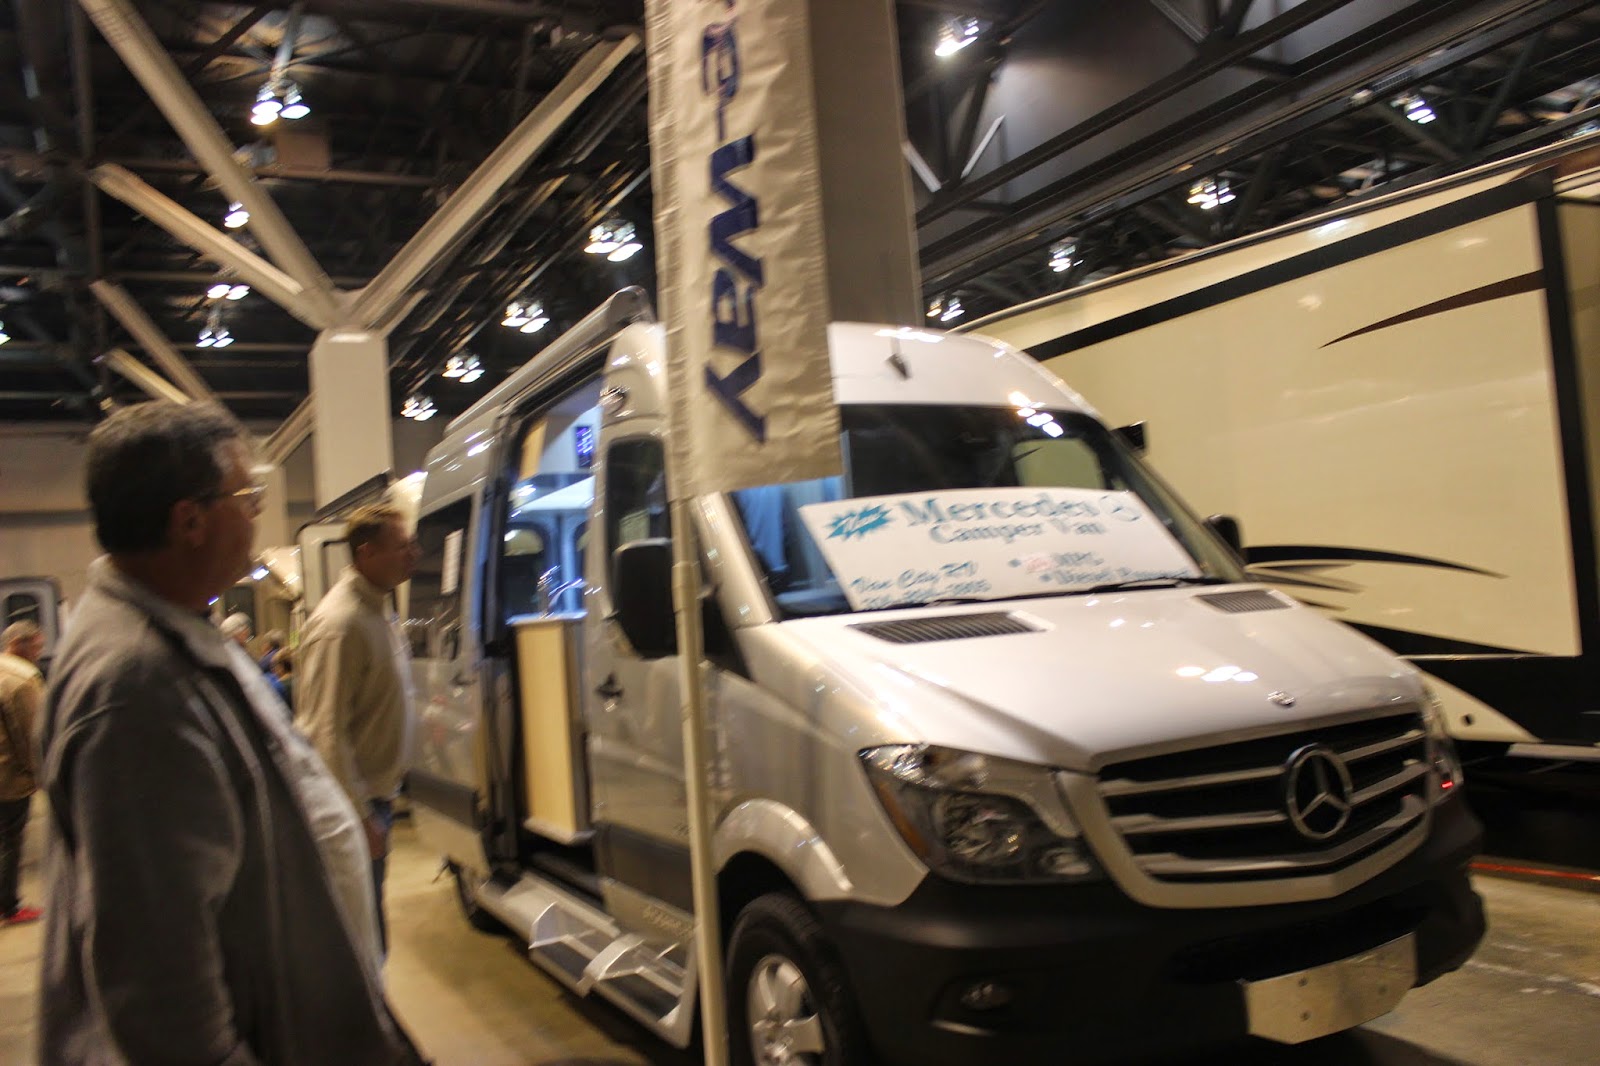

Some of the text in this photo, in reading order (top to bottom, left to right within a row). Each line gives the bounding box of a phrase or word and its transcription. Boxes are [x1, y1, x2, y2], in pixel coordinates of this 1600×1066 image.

[702, 0, 767, 444] e-Way
[898, 492, 1100, 528] Mercedes
[929, 517, 1106, 544] Camper Van
